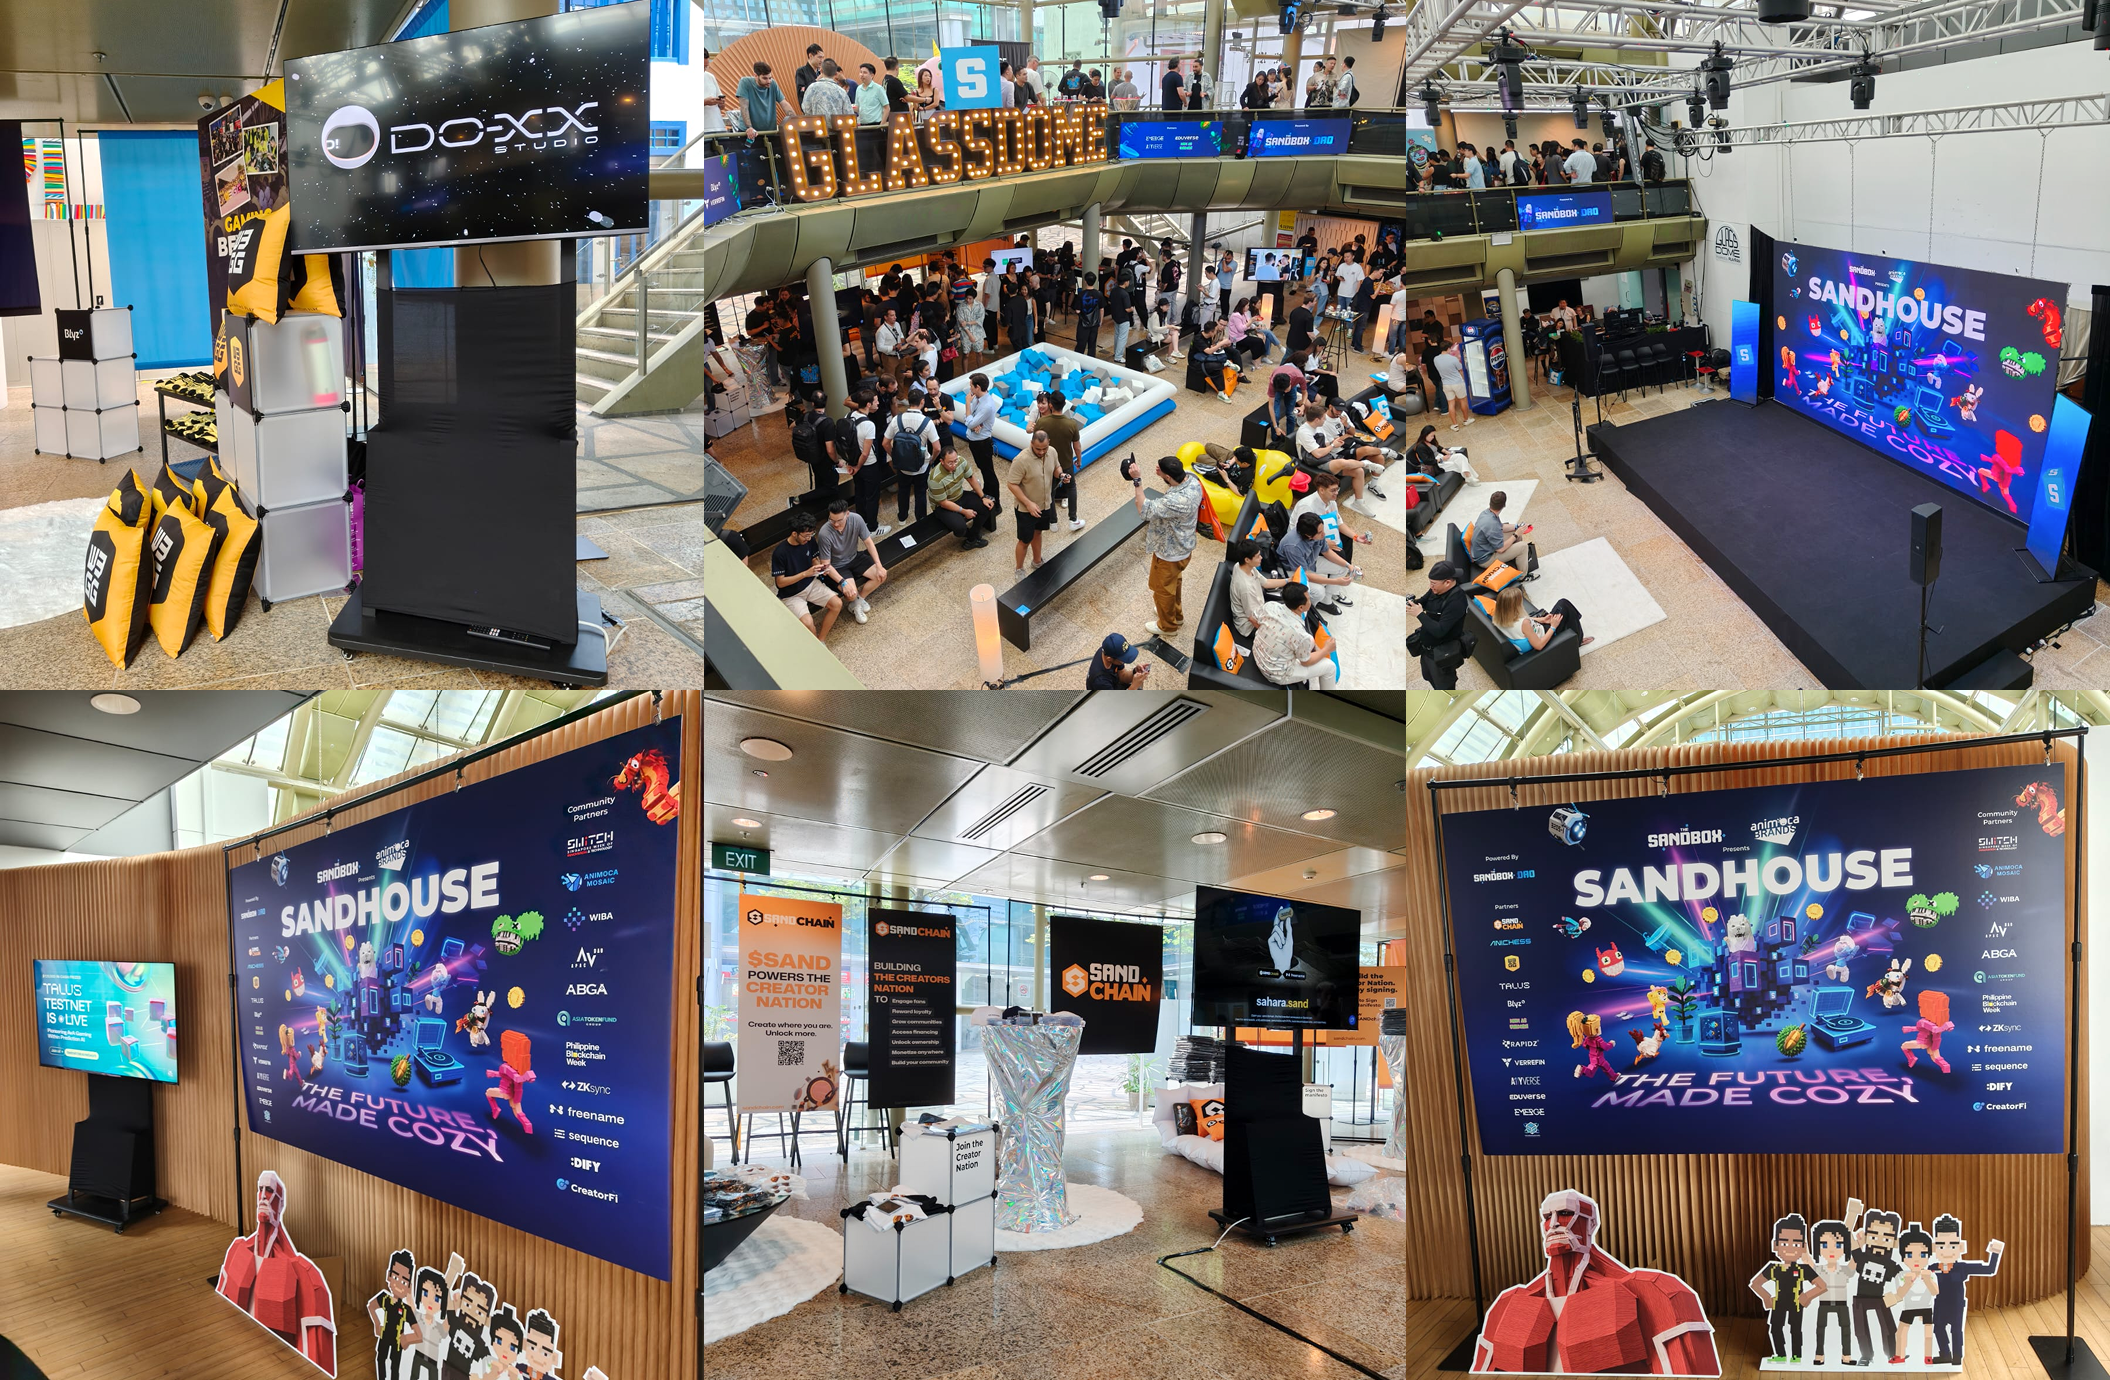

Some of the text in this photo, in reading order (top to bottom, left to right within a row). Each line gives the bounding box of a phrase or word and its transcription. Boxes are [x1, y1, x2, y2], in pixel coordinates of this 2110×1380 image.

[955, 58, 988, 99] S
[494, 135, 599, 154] STUDIO
[1265, 136, 1310, 146] SANDBOX
[780, 103, 1109, 203] GLASSDOME
[1535, 209, 1578, 220] SANDBOX
[1715, 246, 1740, 259] DOME
[1808, 276, 1987, 342] SANDHOUSE
[1739, 348, 1750, 361] S
[1802, 395, 1980, 487] MADE COZY
[2048, 483, 2060, 504] S
[567, 796, 616, 814] Community
[573, 808, 609, 823] Partners
[1977, 809, 2018, 818] Community
[1983, 818, 2013, 826] Partners
[1647, 829, 1723, 848] SANDBOX
[1754, 825, 1797, 839] BRANDS
[1722, 845, 1751, 853] Presents
[725, 852, 757, 870] EXIT
[316, 861, 359, 884] SANDBOX
[584, 869, 619, 880] ANIMOCA
[1473, 871, 1514, 883] SANDBOX
[1573, 847, 1914, 908] SANDHOUSE
[586, 877, 615, 887] MOSAIC
[281, 861, 500, 938] SANDHOUSE
[1999, 895, 2020, 903] WIBA
[589, 911, 614, 921] WIBA
[747, 949, 831, 972] $SAND
[1981, 949, 2018, 960] ABGA
[874, 962, 921, 973] BUILDING
[1089, 963, 1140, 984] SAND
[747, 970, 831, 983] POWERS THE
[874, 973, 951, 984] THE CREATORS
[43, 982, 83, 997] TALUS
[566, 983, 608, 996] ABGA
[746, 981, 829, 996] CREATOR
[874, 984, 914, 993] NATION
[1089, 981, 1152, 1002] CHAIN
[1499, 982, 1531, 990] TALUS
[44, 997, 92, 1012] TESTNET
[756, 995, 823, 1010] NATION
[874, 995, 889, 1004] TO
[1256, 996, 1309, 1009] sahara.sand
[1982, 994, 2012, 1002] Philippine
[46, 1012, 88, 1027] IS LIVE
[748, 1021, 777, 1030] Create
[777, 1021, 800, 1030] where
[801, 1023, 816, 1031] you
[765, 1029, 817, 1038] Unlock more.
[1993, 1024, 2022, 1033] ZKsync
[566, 1041, 600, 1052] Philippine
[1984, 1044, 2032, 1053] freename
[566, 1050, 606, 1061] Blockchain
[566, 1057, 587, 1067] Week
[1985, 1062, 2028, 1072] sequence
[1614, 1073, 1696, 1088] THE
[301, 1081, 344, 1101] THE
[577, 1081, 611, 1095] ZKsync
[1591, 1084, 1920, 1108] MADE COZY
[1986, 1102, 2027, 1110] CreatorFi
[567, 1106, 625, 1125] freename
[291, 1095, 504, 1163] MADE COZY
[568, 1131, 620, 1149] sequence
[955, 1139, 984, 1152] Join the
[955, 1149, 982, 1162] Creator
[955, 1160, 979, 1172] Nation
[571, 1184, 619, 1204] CreatorFi
